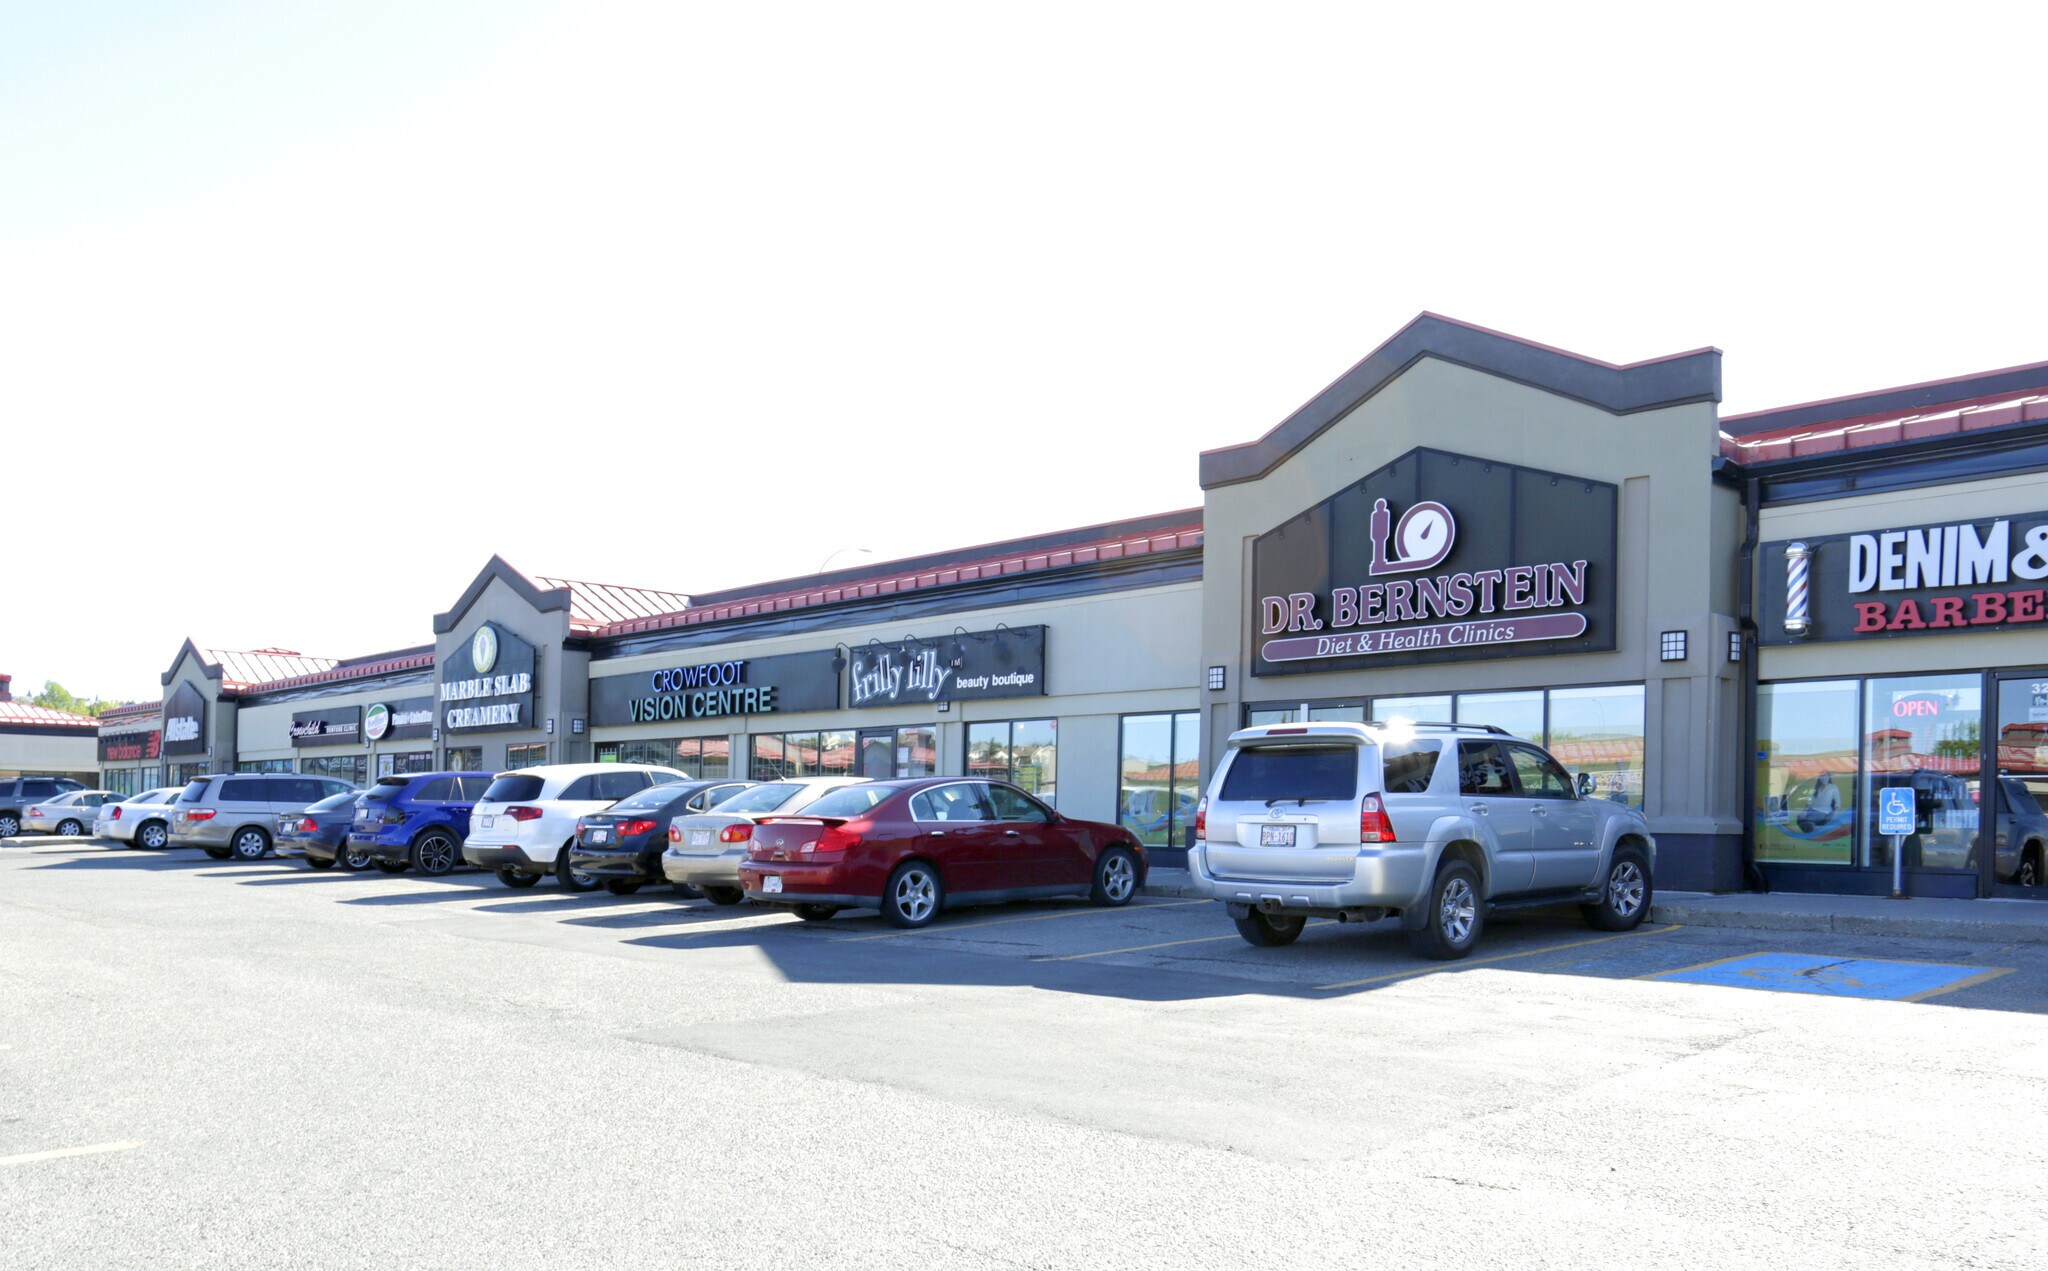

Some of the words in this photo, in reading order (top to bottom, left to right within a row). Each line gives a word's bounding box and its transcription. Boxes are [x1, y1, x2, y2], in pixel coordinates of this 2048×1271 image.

[1848, 519, 2010, 594] DENIM
[1262, 592, 1324, 634] DR.
[1332, 560, 1588, 628] BERNSTEIN
[1853, 589, 2048, 632] BARBE
[1316, 637, 1353, 656] Diet
[1357, 633, 1373, 651] &
[1378, 626, 1441, 649] Health
[1448, 624, 1515, 643] Clinics
[440, 677, 494, 702] MARBLE
[494, 672, 531, 697] SLAB
[652, 660, 744, 693] CROWFOOT
[852, 652, 904, 702] frilly
[907, 650, 951, 700] lilly
[956, 676, 989, 690] beauty
[992, 672, 1034, 687] boutique
[447, 703, 520, 729] CREAMERY
[629, 694, 686, 722] VISION
[692, 686, 772, 718] CENTRE
[1893, 700, 1939, 718] OPEN
[165, 716, 198, 742] Allstate
[287, 719, 321, 739] Crowchild
[107, 747, 118, 760] new
[118, 743, 141, 760] balance
[1881, 823, 1913, 831] REQUIRED
